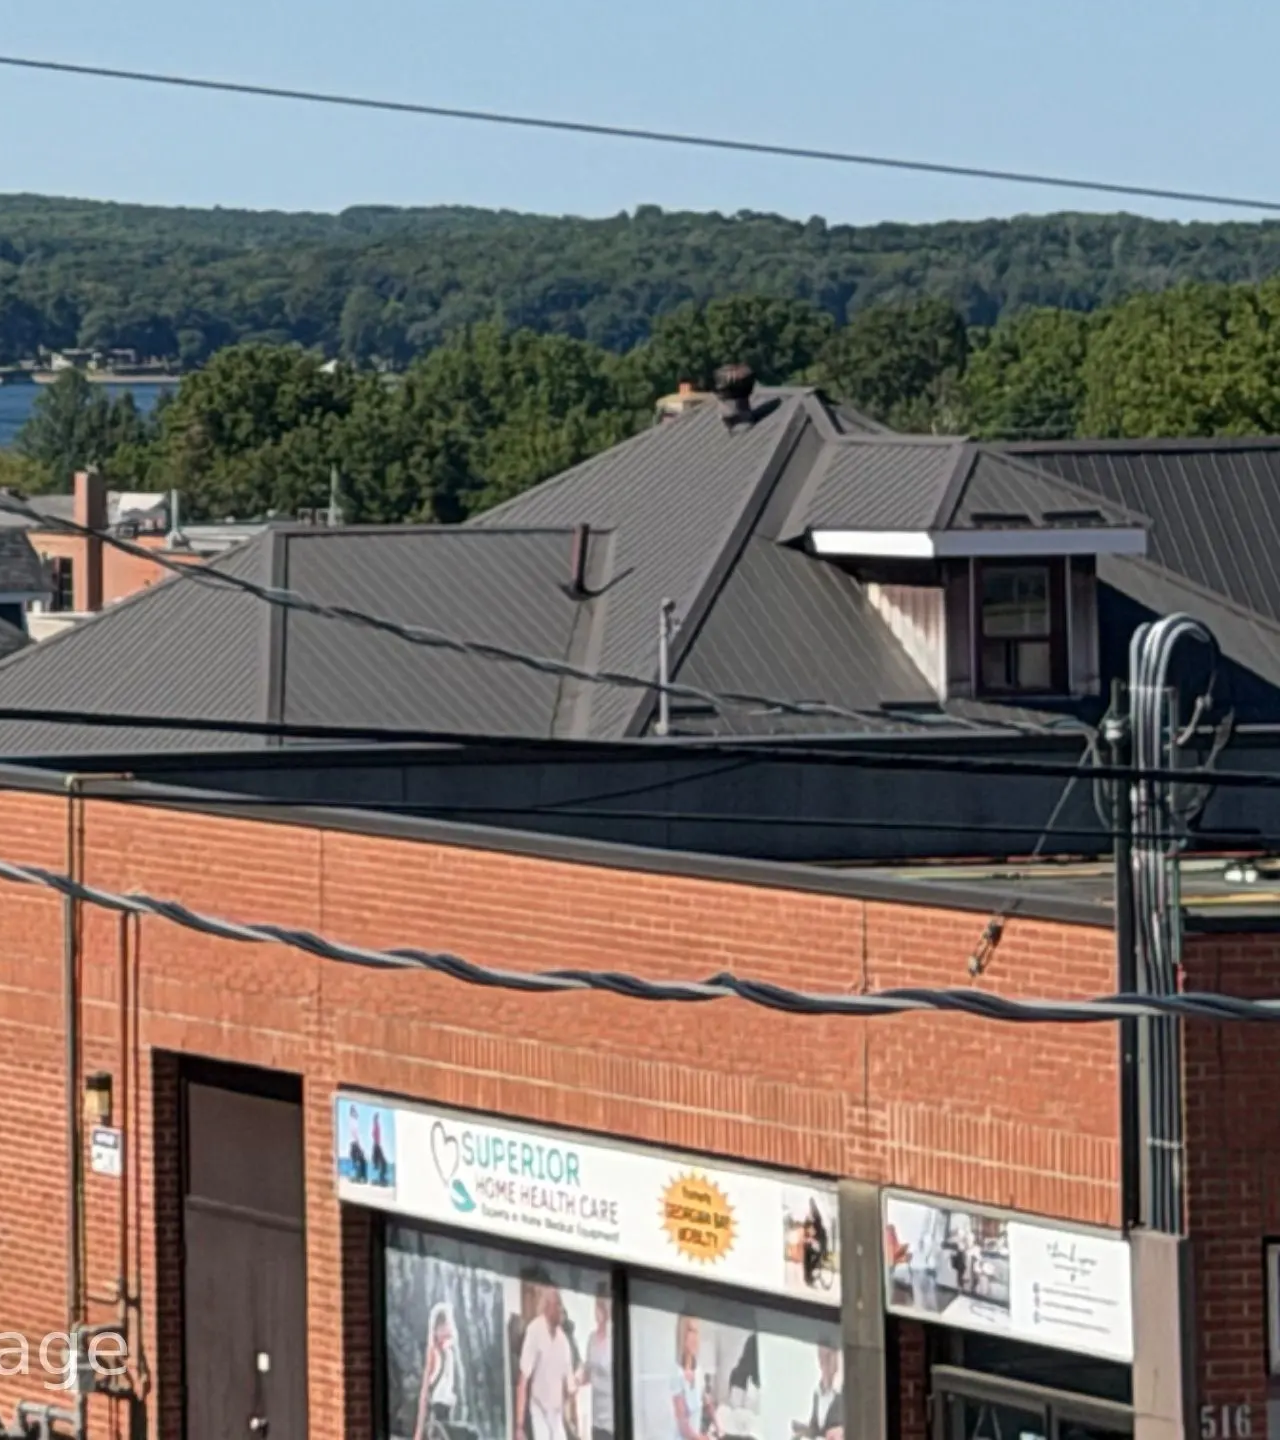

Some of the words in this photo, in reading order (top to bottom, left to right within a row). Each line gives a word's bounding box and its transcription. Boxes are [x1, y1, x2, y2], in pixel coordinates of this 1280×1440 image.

[462, 1130, 581, 1187] SUPERIOR
[476, 1175, 517, 1206] HOME
[520, 1183, 576, 1217] HEALTH
[579, 1193, 618, 1226] CARE
[1201, 1404, 1252, 1440] 516
